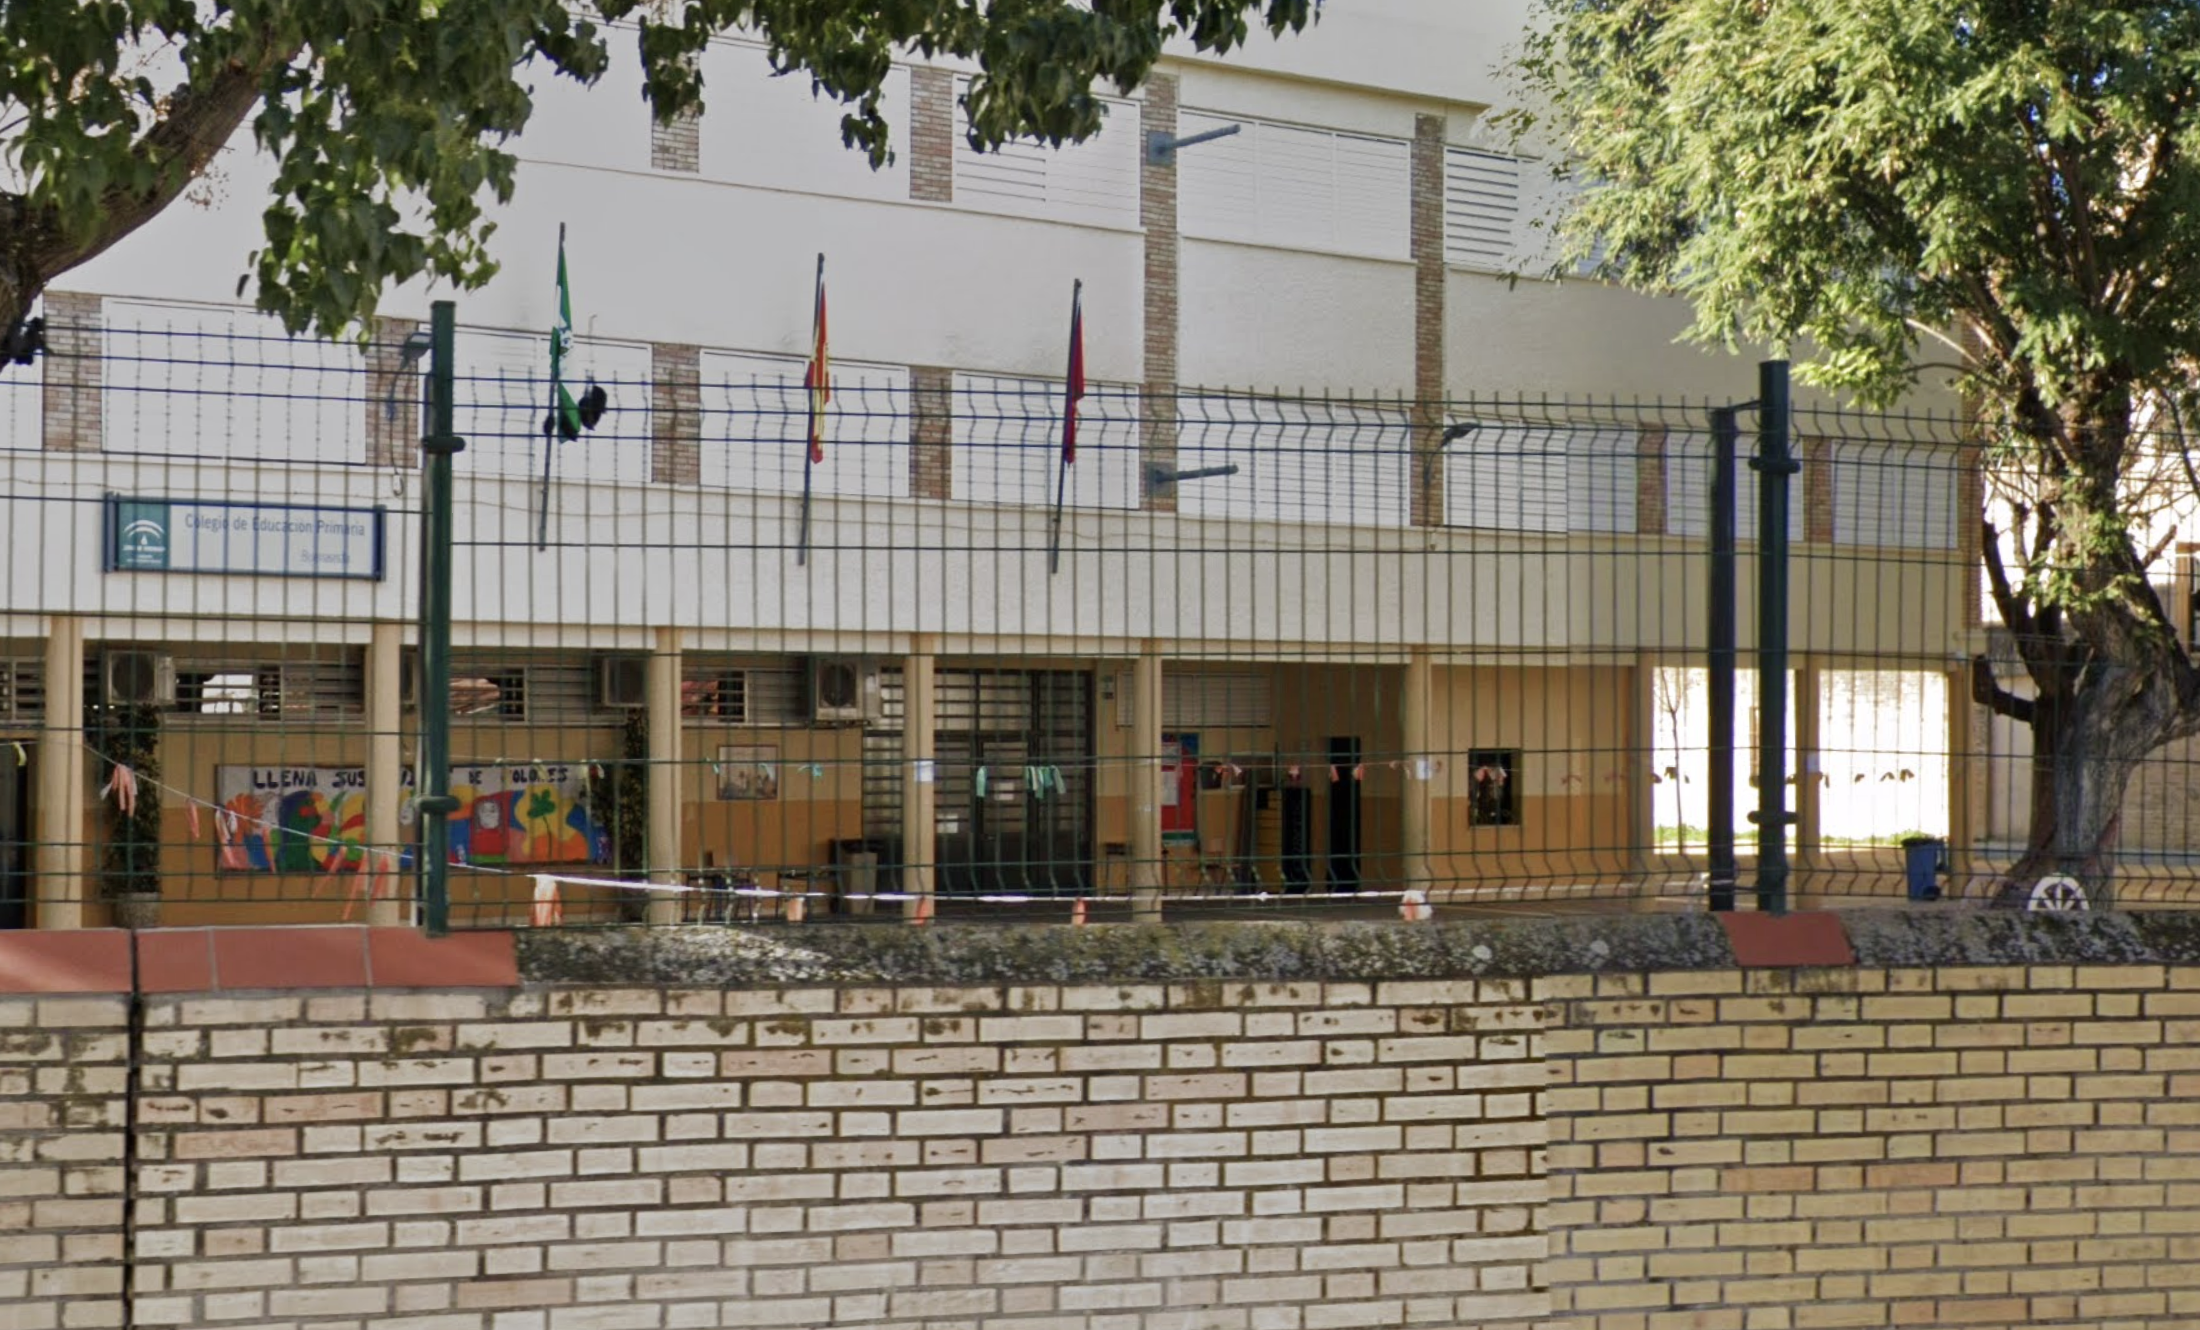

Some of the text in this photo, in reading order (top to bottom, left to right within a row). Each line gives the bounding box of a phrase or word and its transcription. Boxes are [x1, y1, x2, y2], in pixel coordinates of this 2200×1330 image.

[185, 513, 229, 533] Colegio
[233, 516, 248, 530] de
[316, 519, 366, 536] Primaria
[252, 769, 318, 789] LLENA
